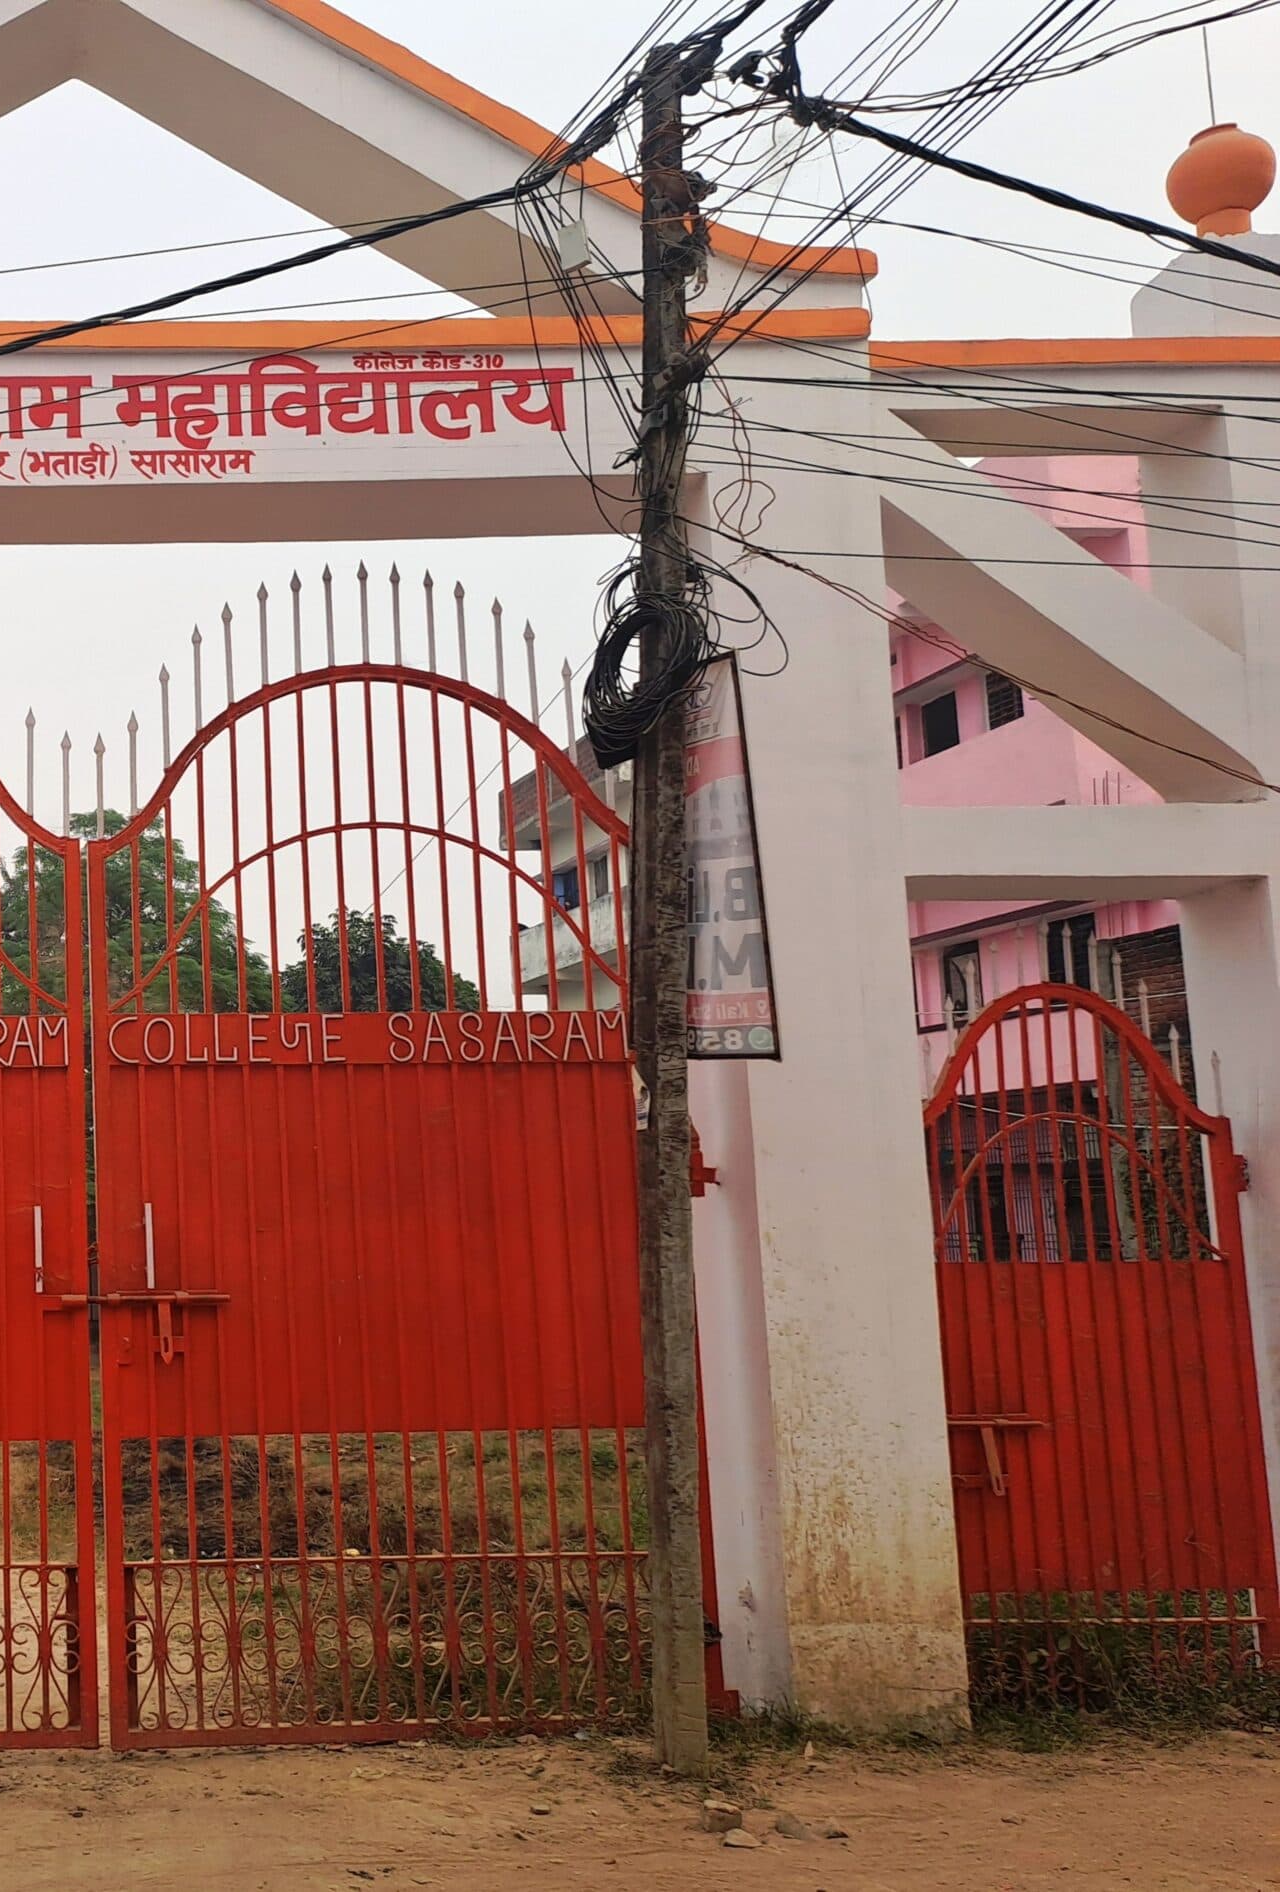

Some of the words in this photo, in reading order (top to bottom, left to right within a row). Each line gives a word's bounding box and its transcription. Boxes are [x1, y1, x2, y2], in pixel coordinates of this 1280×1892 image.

[112, 354, 575, 450] महाविद्यालय
[130, 450, 256, 480] सासाराम
[388, 1011, 629, 1062] SASARAM
